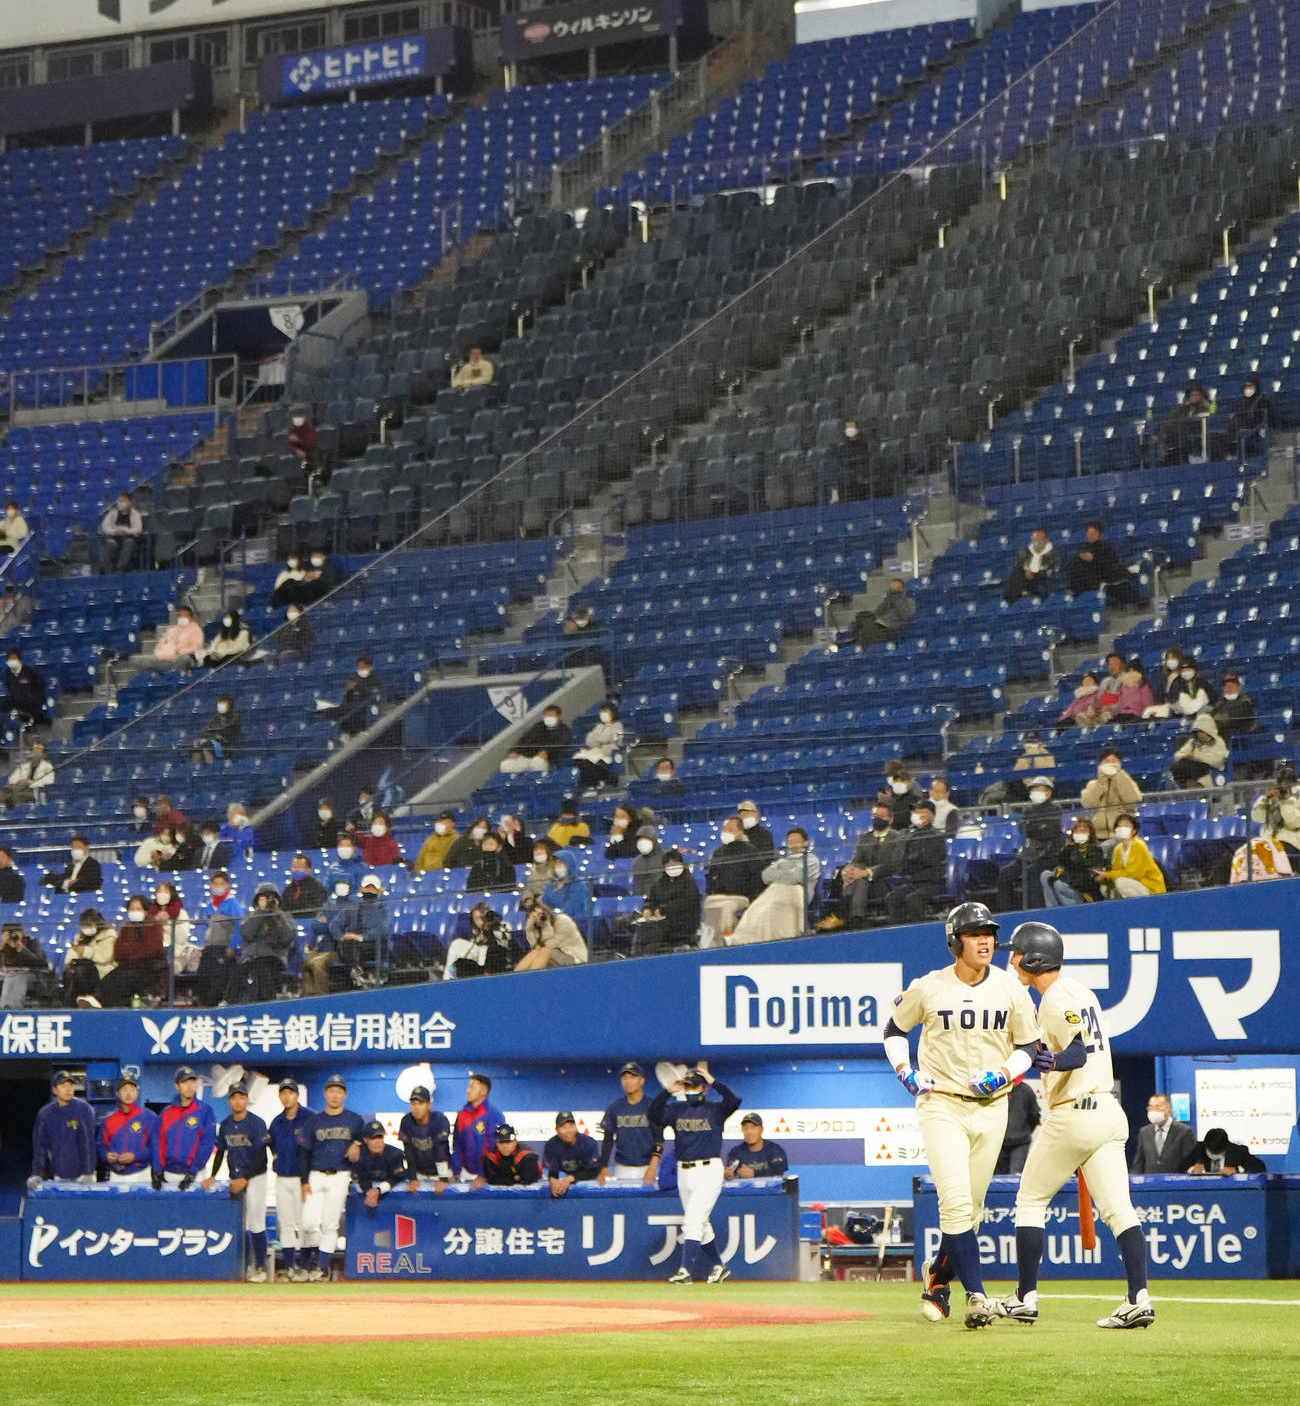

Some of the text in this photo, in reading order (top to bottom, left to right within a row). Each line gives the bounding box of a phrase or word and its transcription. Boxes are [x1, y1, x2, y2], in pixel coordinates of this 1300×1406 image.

[553, 6, 652, 37] ウィルキンソン
[324, 41, 419, 78] ヒトトヒト
[1004, 928, 1281, 1039] ジマ
[0, 1013, 72, 1054] 保証
[181, 1011, 456, 1053] 横浜幸銀信用組合
[938, 1009, 1008, 1030] TOIN
[1080, 1006, 1104, 1053] 24
[796, 1119, 856, 1133] ミツウロコ
[59, 1227, 233, 1257] インタープラン
[443, 1213, 777, 1266] 分譲住宅 リアル
[924, 1224, 1242, 1270] Pemum tyle
[357, 1252, 432, 1274] REAL
